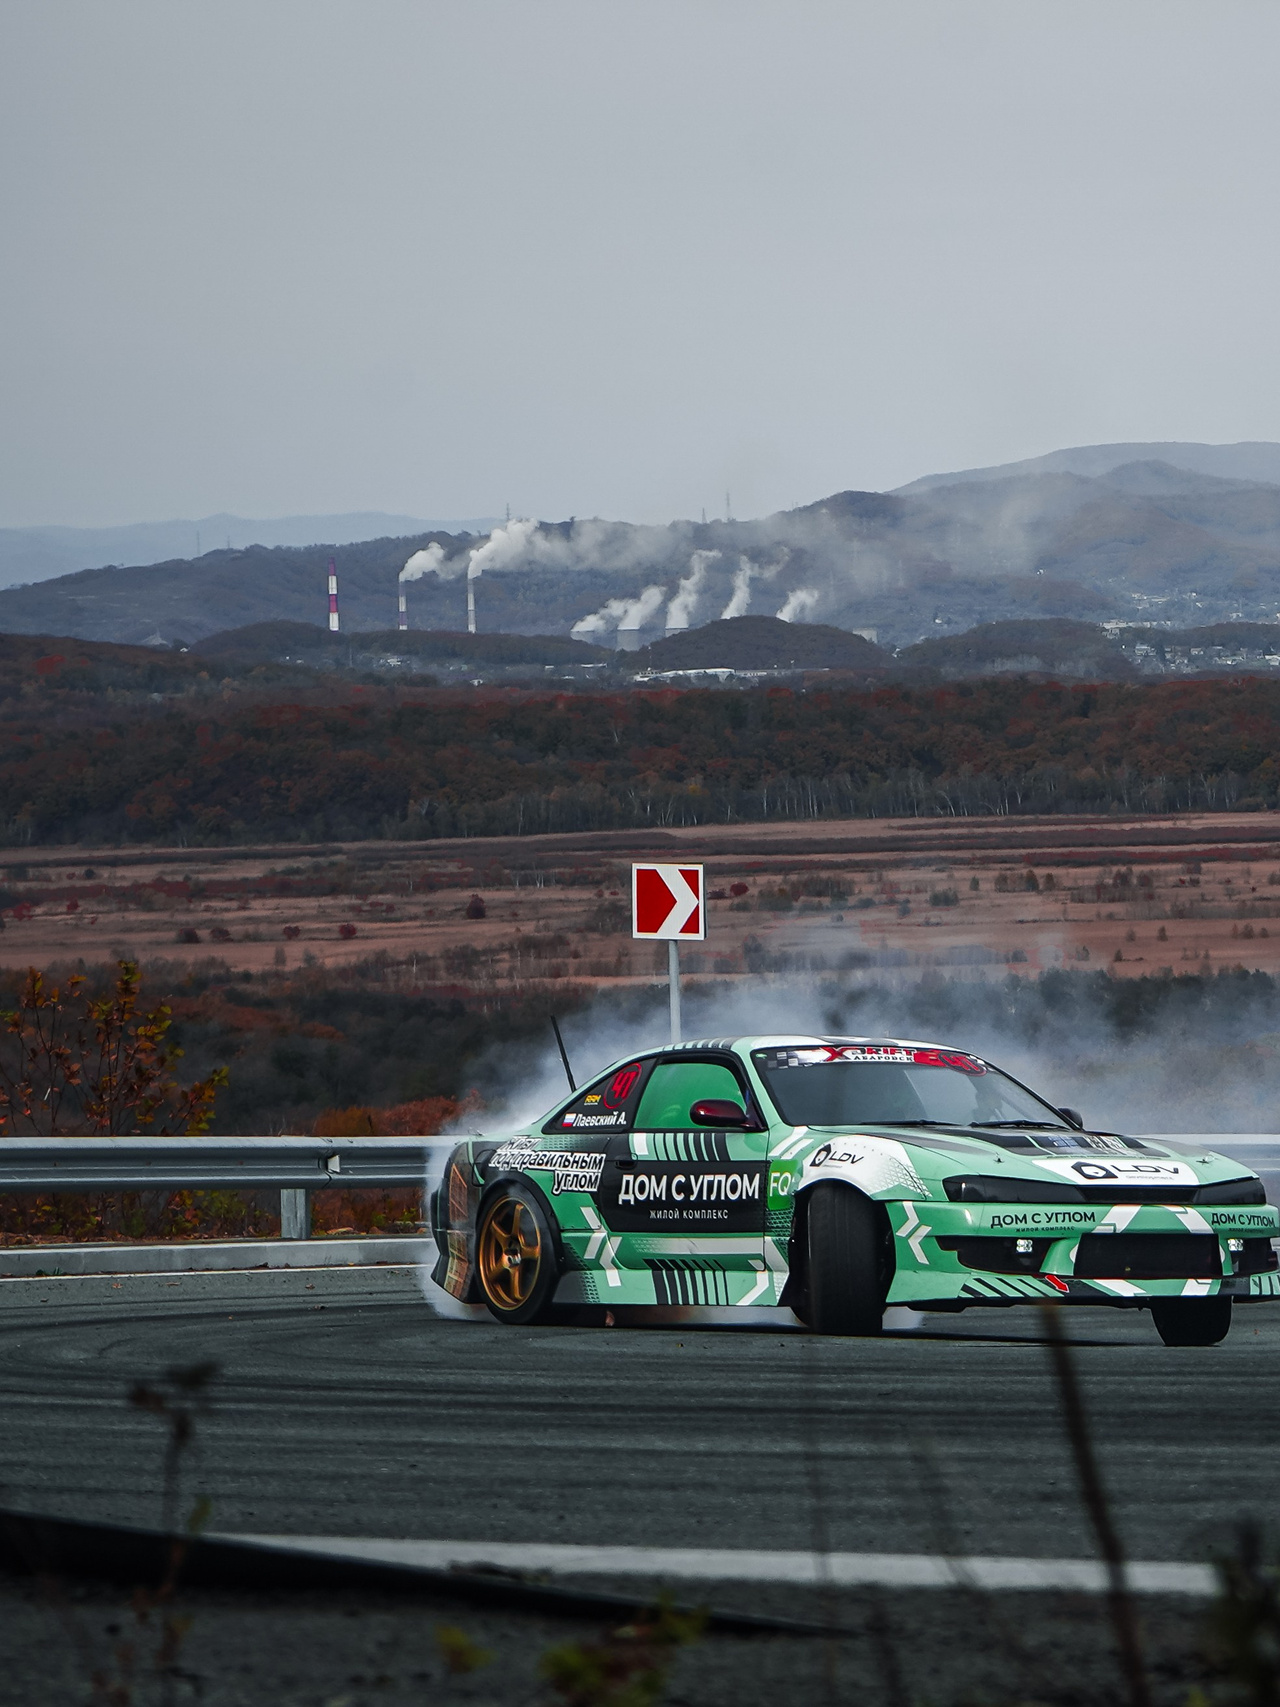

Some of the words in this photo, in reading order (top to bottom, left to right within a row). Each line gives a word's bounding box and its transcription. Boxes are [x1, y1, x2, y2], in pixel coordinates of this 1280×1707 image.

[573, 1111, 617, 1127] Лаевский
[617, 1111, 627, 1125] А.
[511, 1151, 606, 1173] правильным
[829, 1151, 864, 1164] LDV
[1110, 1164, 1179, 1174] LDV
[618, 1174, 667, 1205] ДОМ
[671, 1174, 686, 1201] С
[690, 1173, 760, 1201] УГЛОМ
[650, 1208, 680, 1219] ЖИЛОЙ
[683, 1209, 729, 1219] КОМПЛЕКС
[990, 1213, 1027, 1229] ДОМ
[1031, 1213, 1041, 1223] С
[1044, 1211, 1096, 1223] УГЛОМ
[1211, 1213, 1236, 1226] ДОМ
[1238, 1214, 1245, 1225] С
